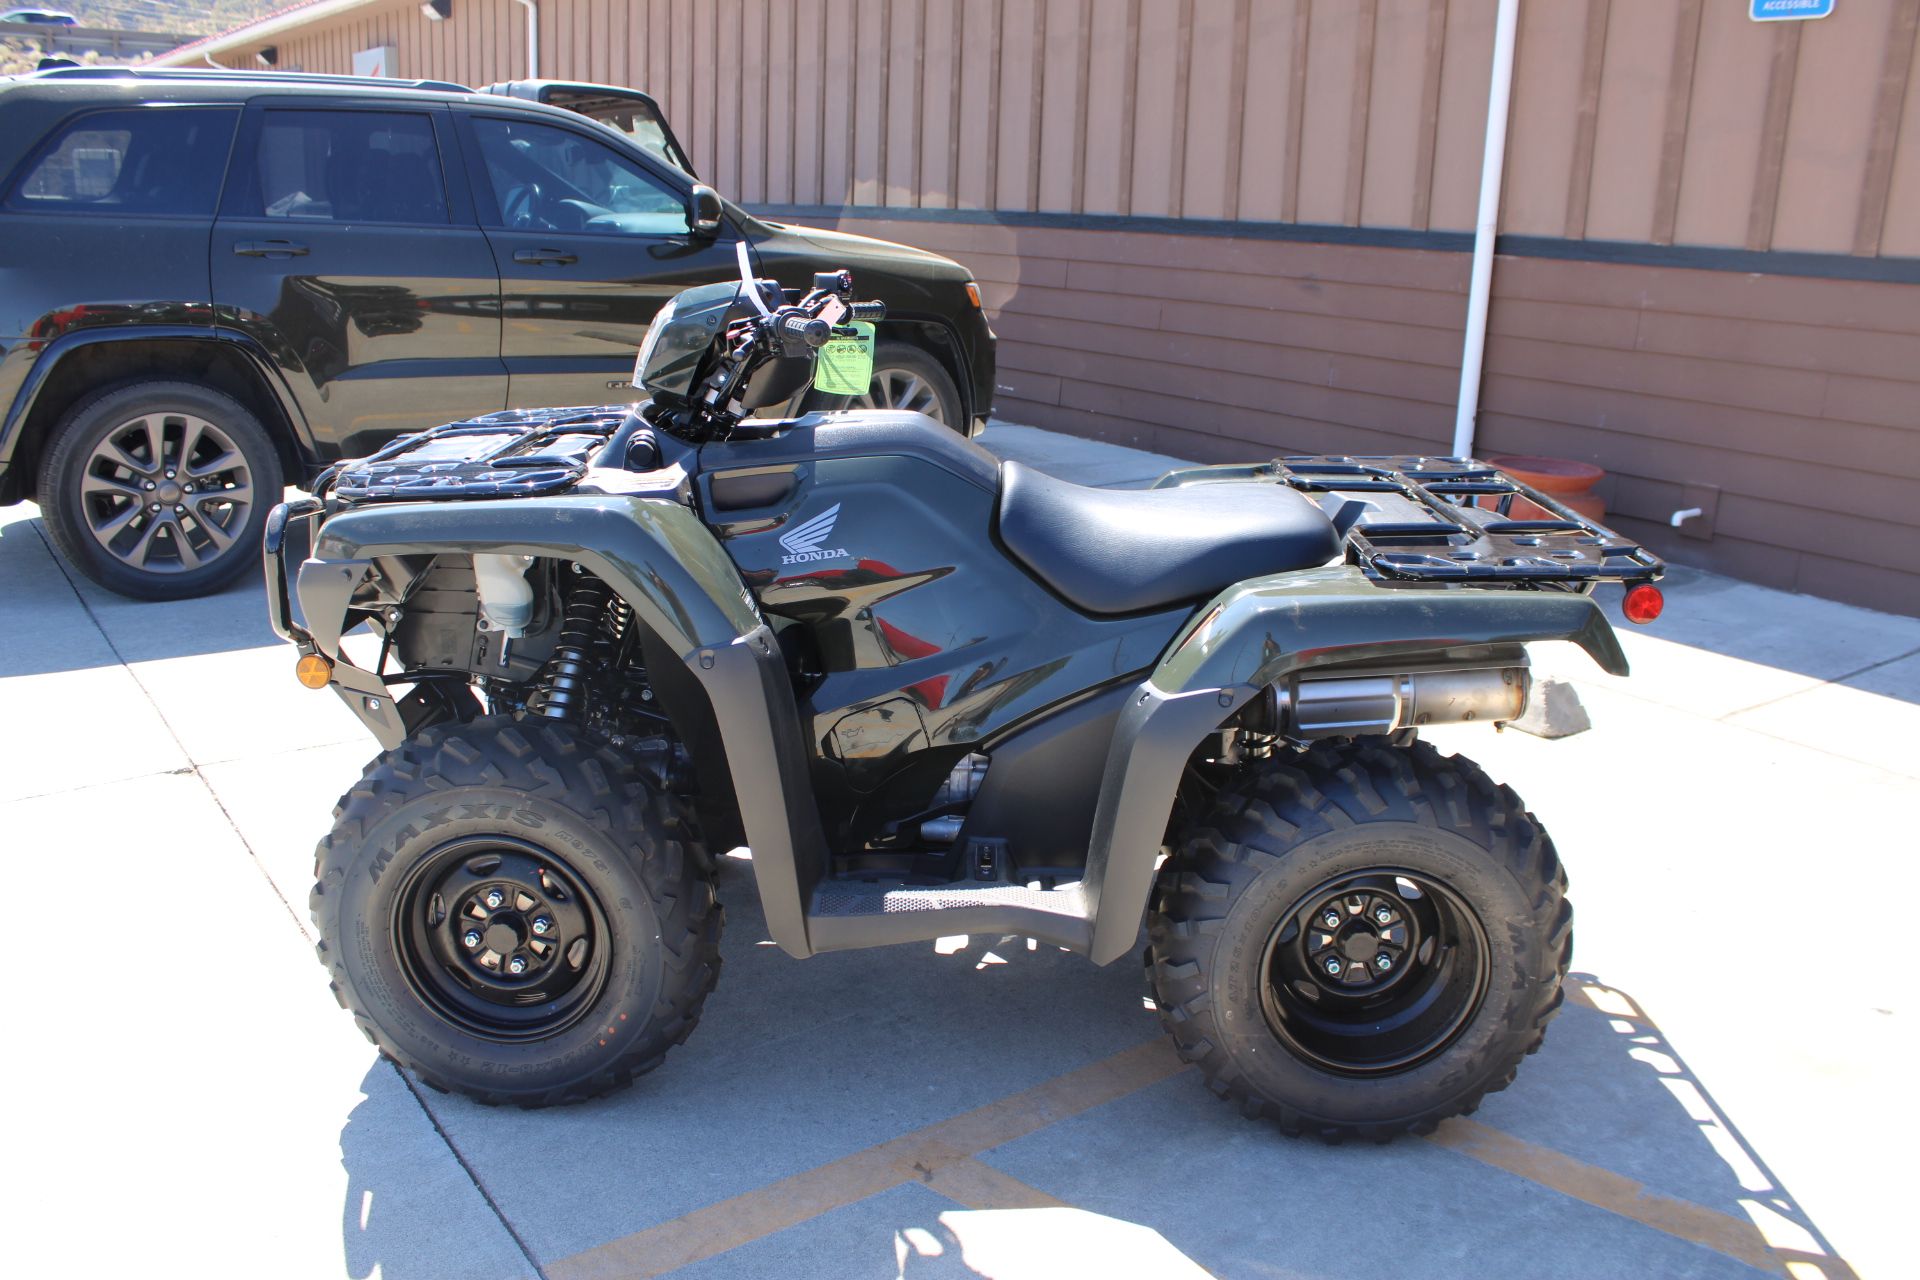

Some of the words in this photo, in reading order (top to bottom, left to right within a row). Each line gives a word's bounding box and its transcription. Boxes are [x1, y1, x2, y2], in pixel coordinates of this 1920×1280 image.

[1763, 0, 1821, 10] ACCESSIBLE
[781, 548, 851, 565] HONDA
[368, 803, 547, 885] MAXXIS
